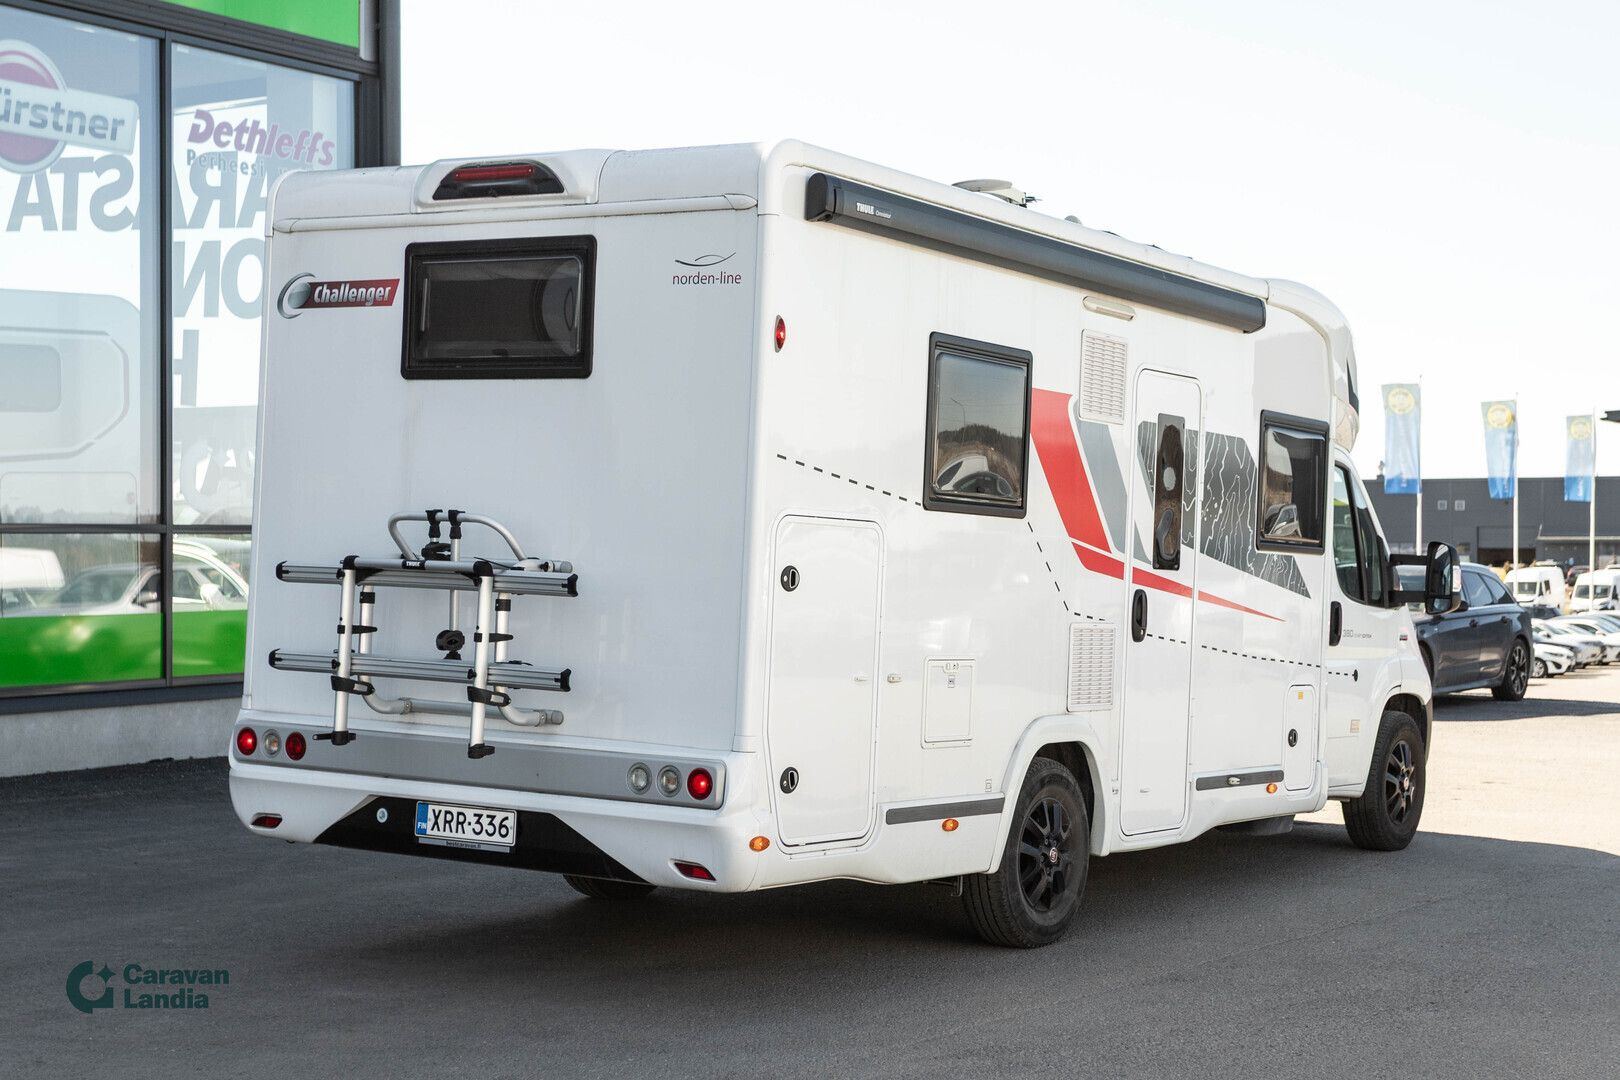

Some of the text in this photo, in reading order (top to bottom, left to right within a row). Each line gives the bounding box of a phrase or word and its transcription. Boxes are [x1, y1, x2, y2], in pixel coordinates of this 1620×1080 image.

[187, 109, 335, 166] Dethleffs
[187, 149, 265, 178] Perheesi
[856, 202, 875, 215] THULE
[672, 271, 742, 285] norden-line
[313, 283, 391, 306] Challenger
[417, 808, 510, 839] FIN XRR-336
